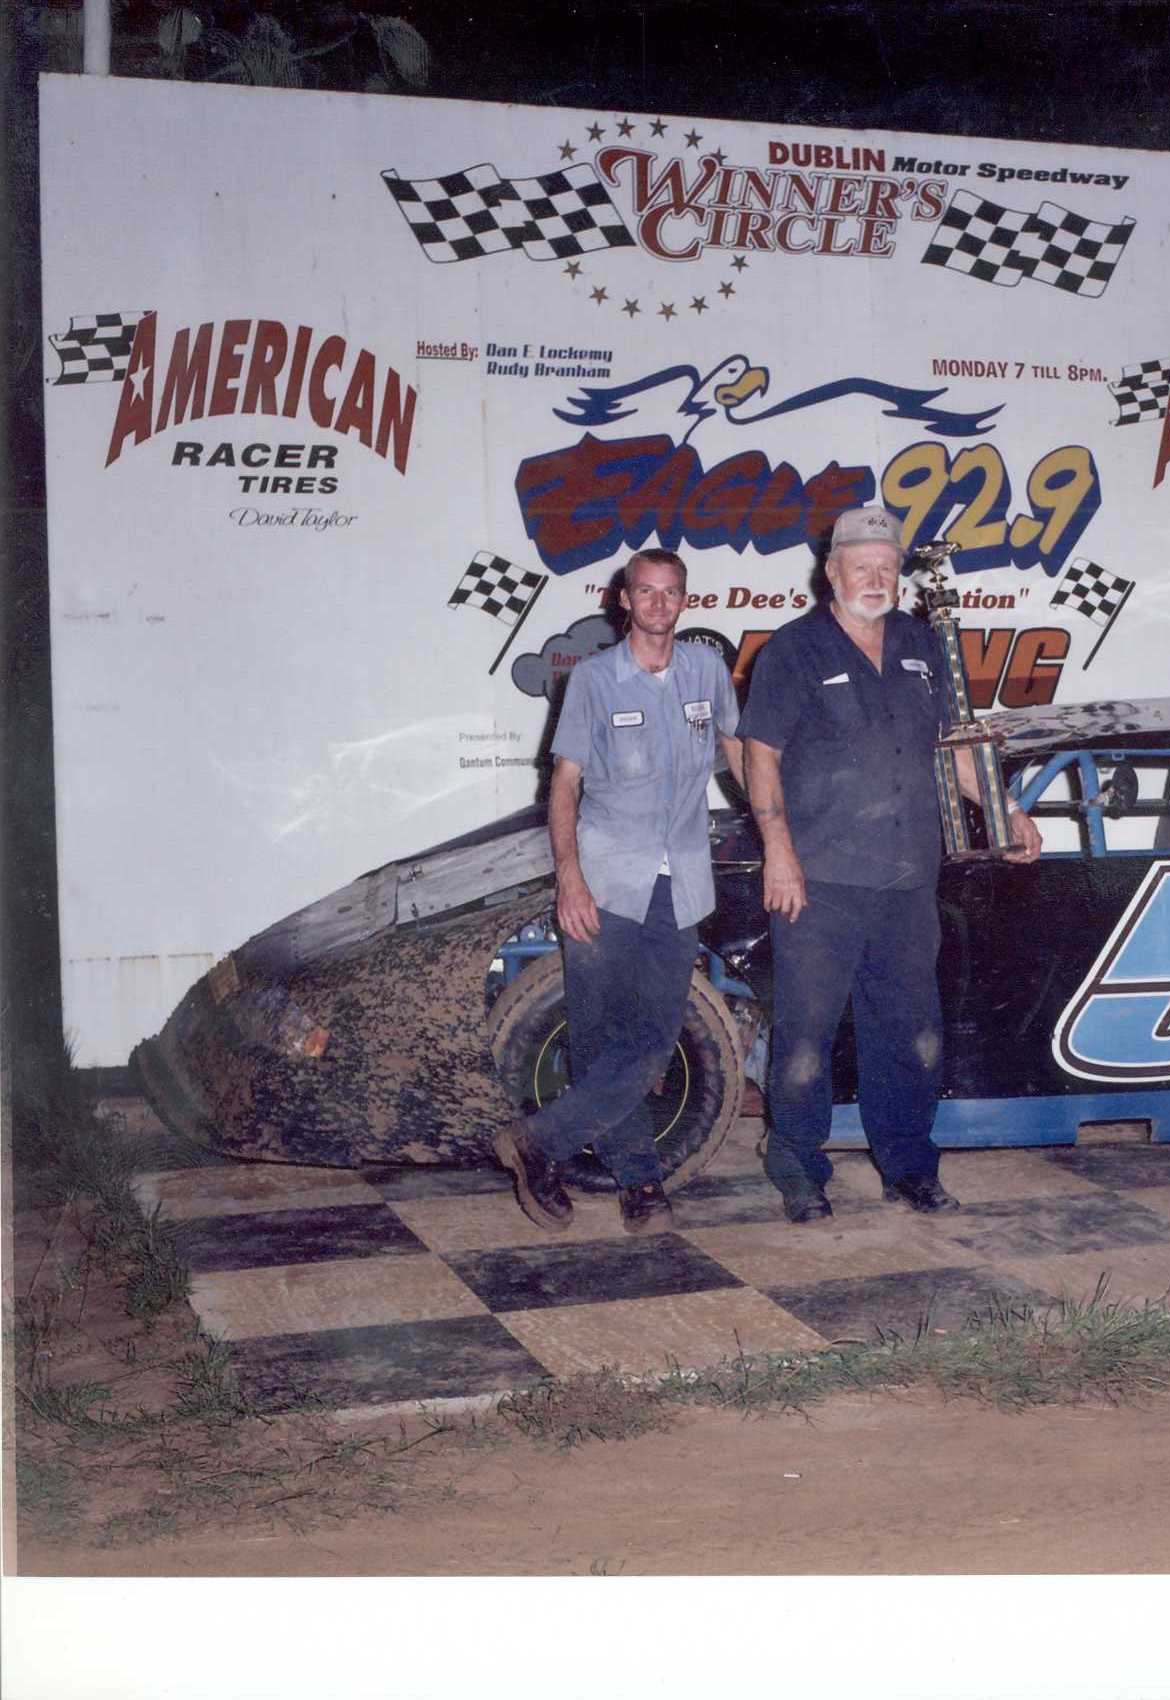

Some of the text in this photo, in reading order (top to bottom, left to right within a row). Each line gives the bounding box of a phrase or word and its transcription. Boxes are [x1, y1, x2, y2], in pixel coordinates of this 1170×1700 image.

[769, 141, 1130, 190] DUBLIN Motor Speedway
[595, 145, 950, 223] WINNER'S
[638, 200, 897, 262] CIRCLE
[416, 340, 479, 361] Hosted By:
[486, 342, 517, 358] Dan
[487, 361, 611, 379] Rudy Branham
[932, 359, 1107, 383] MONDAY 7 TILL 8PM.
[105, 311, 418, 476] AMERICAN
[171, 441, 339, 469] RACER
[238, 475, 338, 495] TIRES
[515, 432, 875, 575] EAGLE
[881, 441, 1101, 577] 92.9
[229, 507, 358, 532] David Taylor
[726, 586, 808, 610] Dee's
